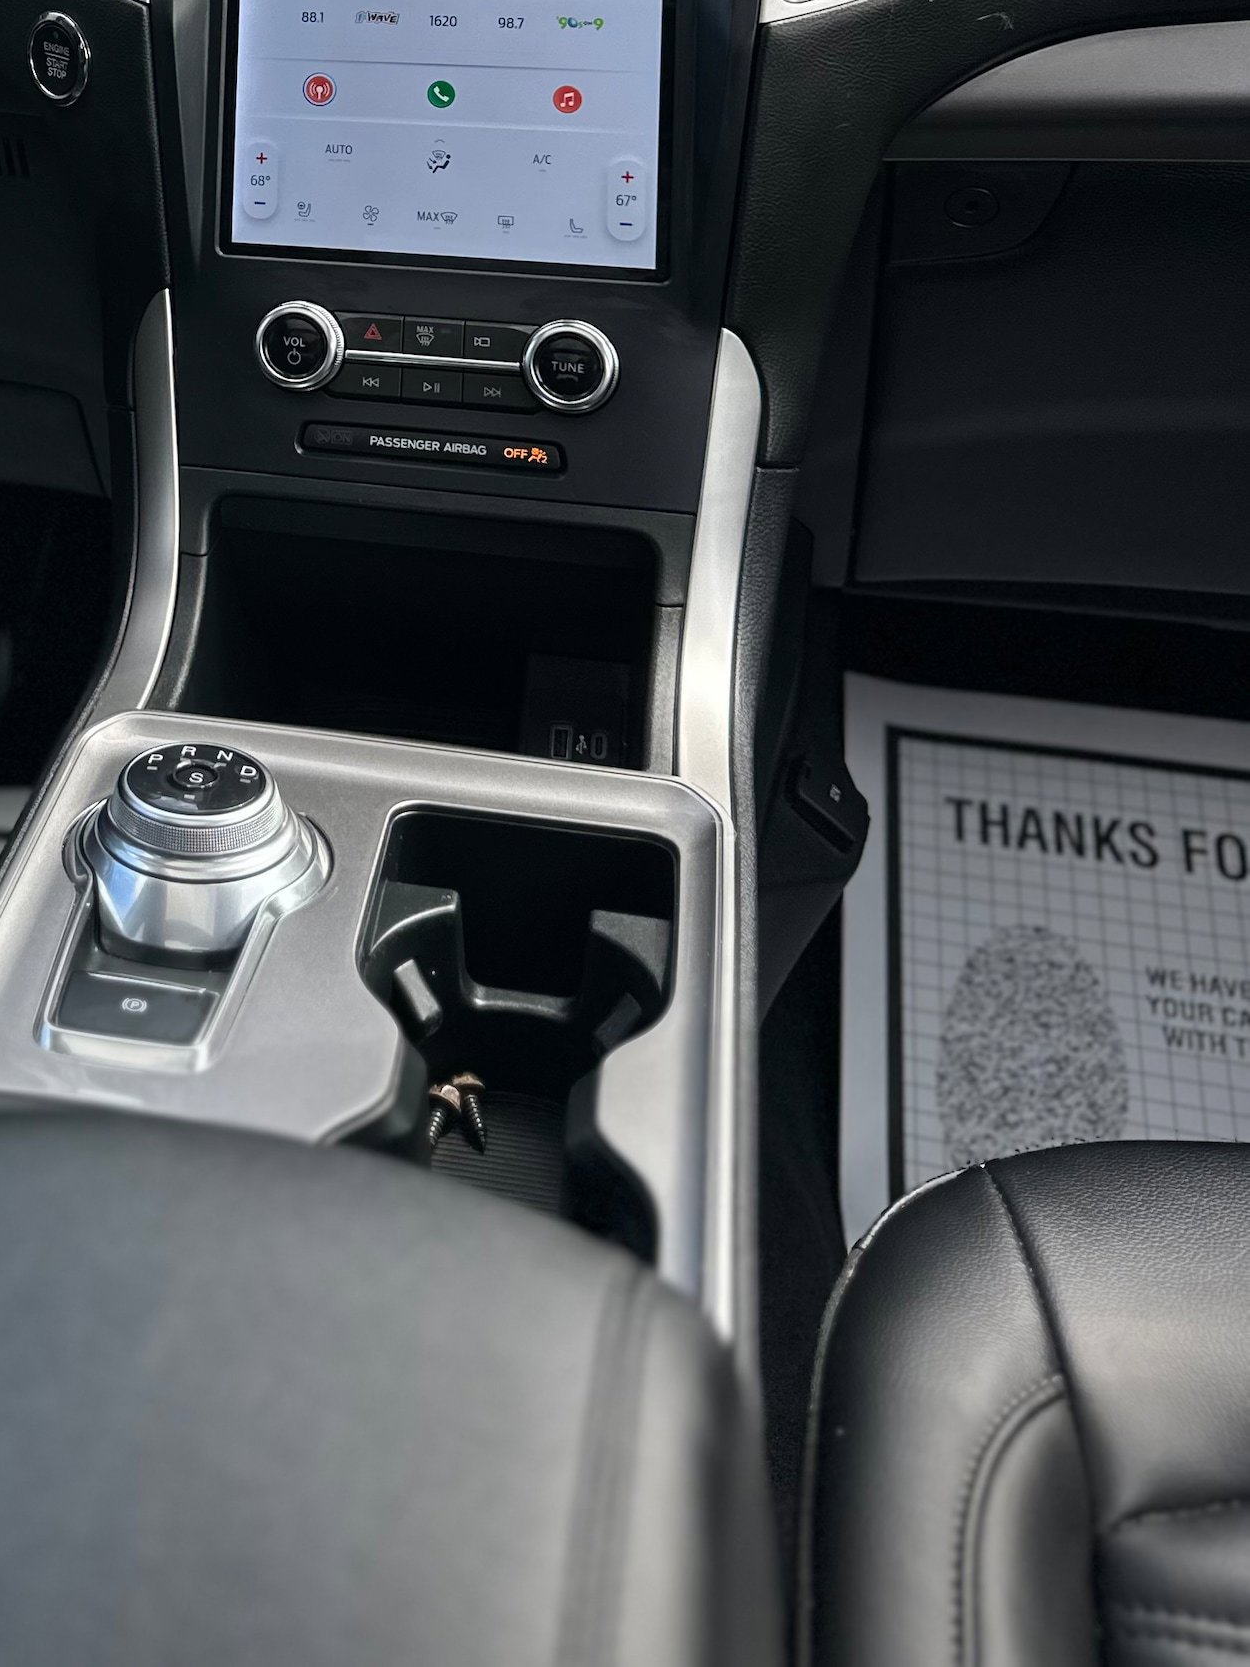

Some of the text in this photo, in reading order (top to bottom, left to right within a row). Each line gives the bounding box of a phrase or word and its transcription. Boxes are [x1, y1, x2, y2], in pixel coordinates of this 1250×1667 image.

[301, 12, 324, 24] 88.1
[429, 15, 458, 28] 1620
[498, 18, 525, 31] 98.7
[43, 41, 70, 56] ENGINE
[46, 57, 68, 69] START
[47, 67, 67, 79] STOP
[325, 144, 353, 156] AUTO
[533, 154, 552, 166] A/C
[250, 175, 271, 187] 68°
[615, 194, 637, 207] 67°
[417, 211, 440, 222] MAX
[416, 325, 435, 335] MAX
[283, 336, 306, 348] VOL
[551, 362, 585, 374] TUNE
[369, 435, 487, 456] PASSENGER AIRBAG
[503, 447, 528, 459] OFF
[148, 745, 257, 777] P R N D
[189, 772, 204, 784] S
[943, 795, 1160, 869] THANKS
[1146, 966, 1250, 1001] WE HAVE
[1146, 994, 1213, 1023] YOUR
[1162, 1025, 1228, 1054] WITH
